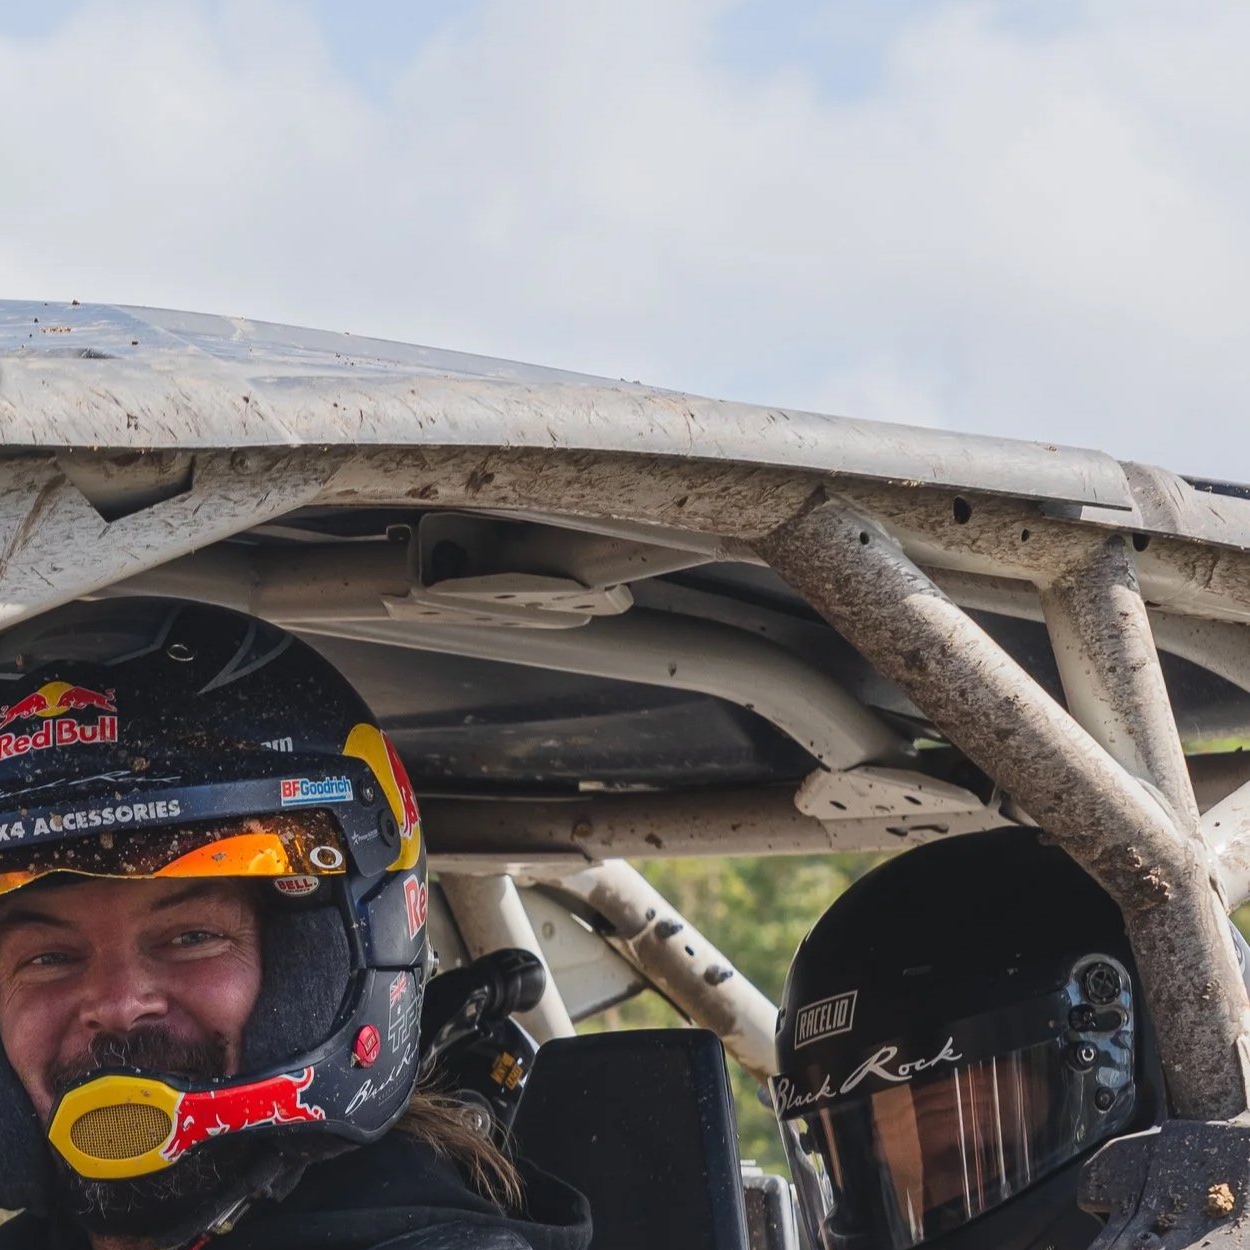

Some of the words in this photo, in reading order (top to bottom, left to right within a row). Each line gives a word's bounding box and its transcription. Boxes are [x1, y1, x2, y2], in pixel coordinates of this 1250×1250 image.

[56, 716, 118, 745] Bull
[281, 775, 351, 798] BFGoodrich
[34, 800, 182, 837] ACCESSORIES
[277, 878, 313, 890] BELL
[774, 1073, 837, 1117] Black
[840, 1036, 963, 1094] Rock
